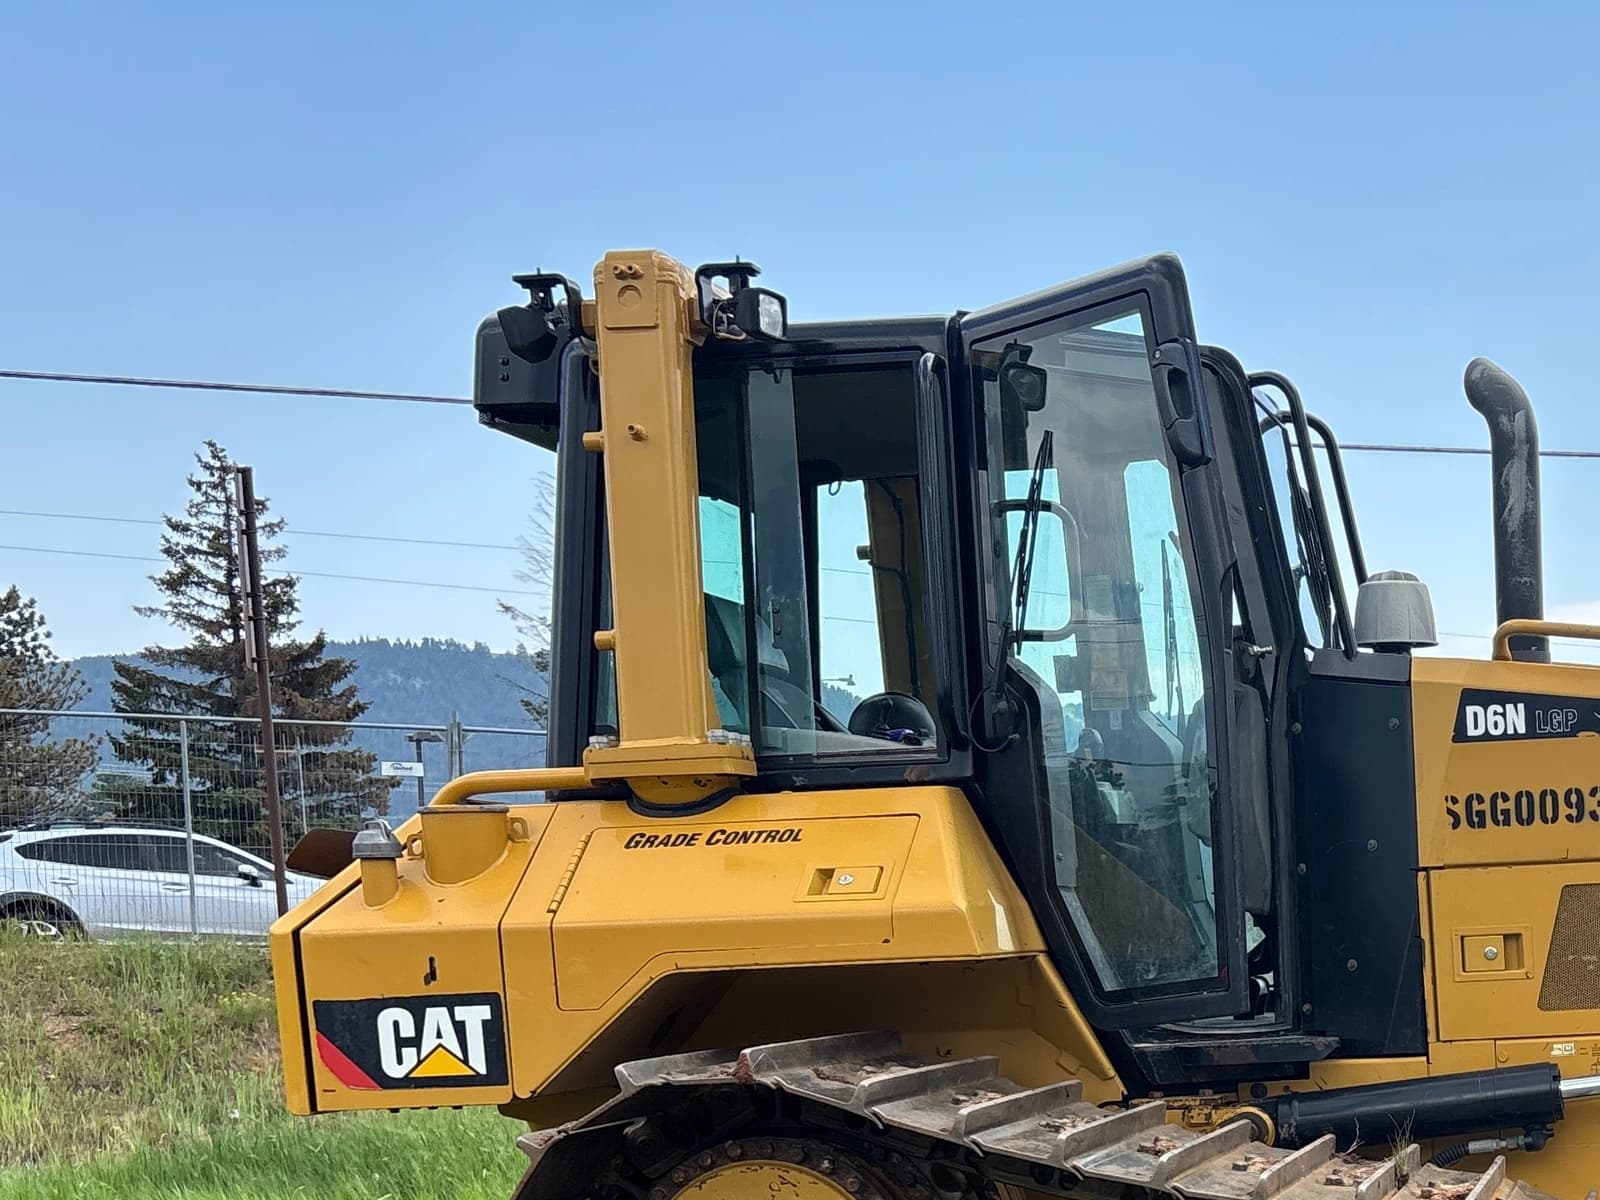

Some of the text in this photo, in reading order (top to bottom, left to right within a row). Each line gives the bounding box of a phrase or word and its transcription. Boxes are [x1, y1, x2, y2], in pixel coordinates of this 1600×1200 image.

[1465, 703, 1578, 737] D6N LGP
[377, 1005, 492, 1079] CAT
